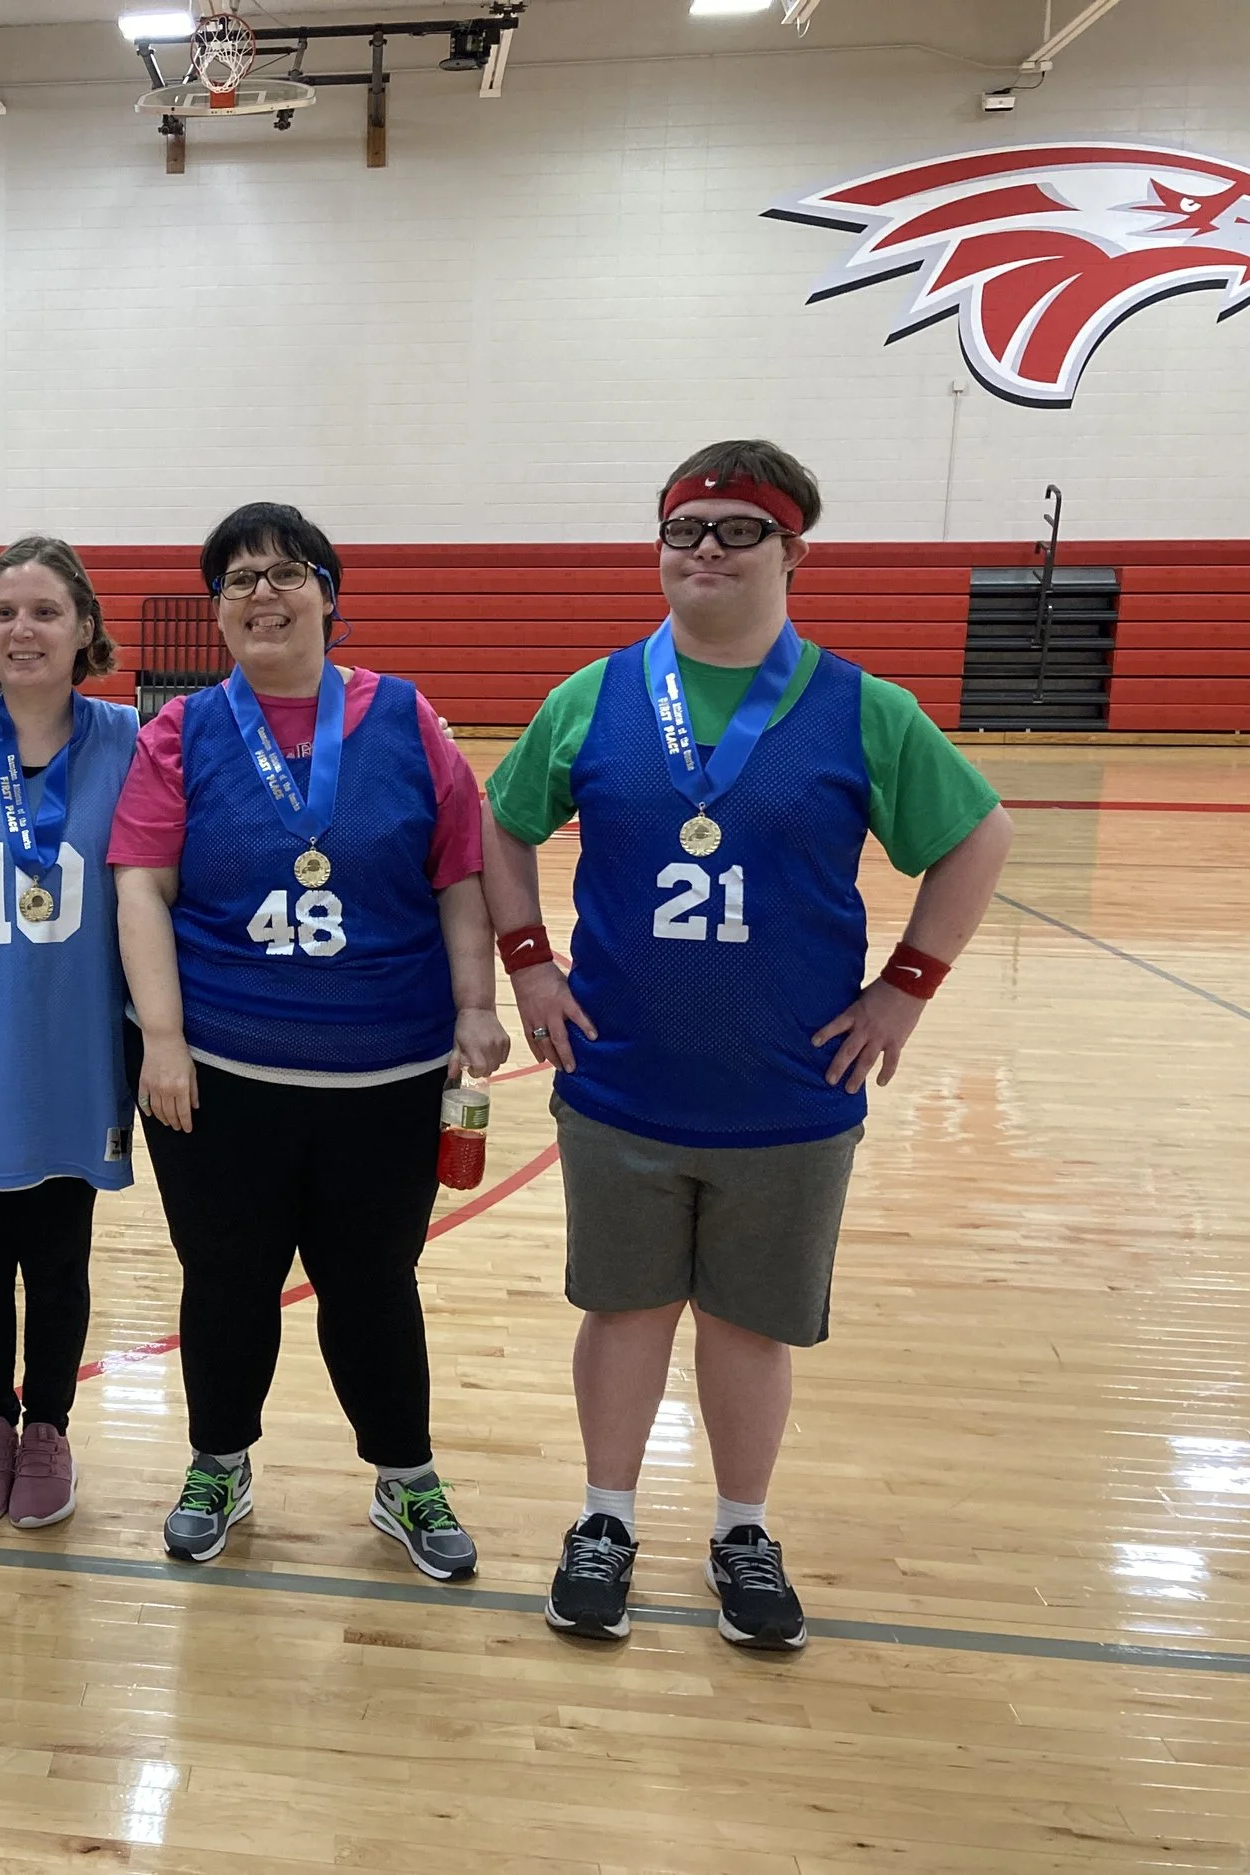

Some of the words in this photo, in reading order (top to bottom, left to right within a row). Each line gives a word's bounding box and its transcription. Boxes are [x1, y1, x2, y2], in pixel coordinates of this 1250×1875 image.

[658, 697, 672, 721] FIRST
[664, 725, 680, 754] PLACE
[0, 776, 12, 800] FIRST
[255, 750, 272, 772] FIRST
[266, 773, 284, 800] PLACE
[5, 805, 19, 833] PLACE
[652, 862, 749, 943] 21
[246, 889, 347, 957] 48
